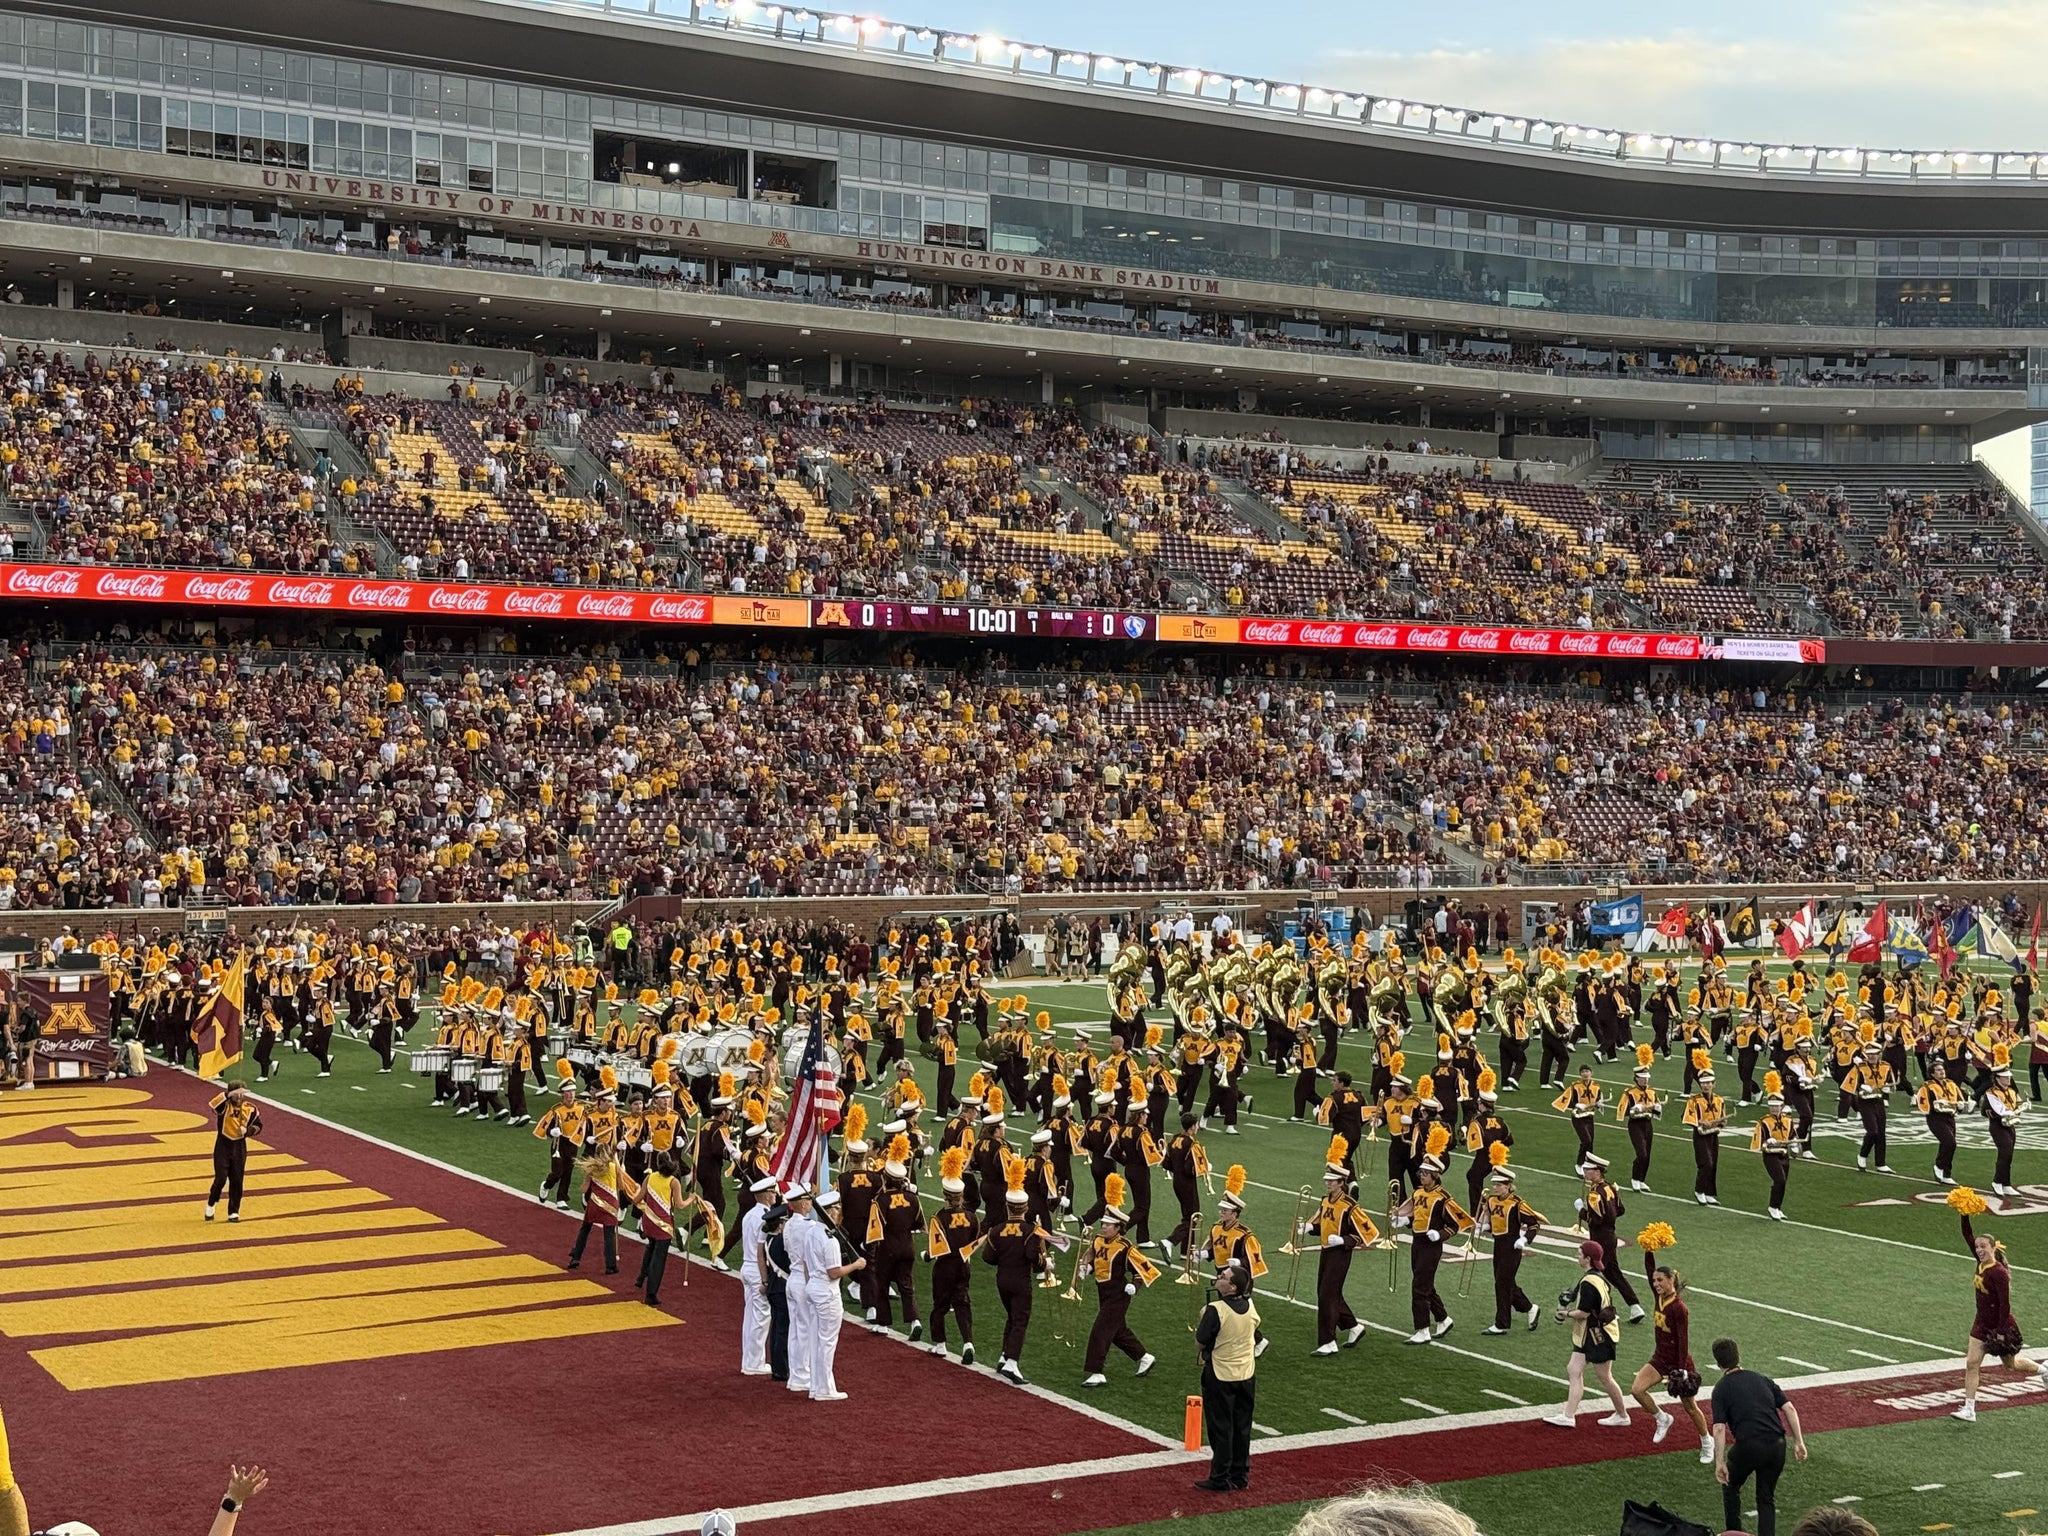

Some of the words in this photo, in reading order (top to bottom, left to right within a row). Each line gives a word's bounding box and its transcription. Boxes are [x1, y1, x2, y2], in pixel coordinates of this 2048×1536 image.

[262, 170, 462, 210] UNIVERSITY
[478, 197, 514, 215] OF
[532, 203, 703, 237] MINNESOTA
[767, 231, 791, 249] M
[857, 241, 1026, 274] HUNTINGTON
[1039, 262, 1104, 282] BANK
[1116, 269, 1221, 294] STADIUM
[9, 569, 83, 594] Coca-Cola
[97, 573, 168, 598] Coca-Cola
[185, 577, 254, 601] Coca-Cola
[268, 580, 335, 604] Coca-Cola
[348, 584, 413, 608] Coca-Cola
[428, 587, 491, 611] Coca-Cola
[504, 591, 565, 614] Coca-Cola
[576, 594, 636, 617] Coca-Cola
[649, 597, 706, 620] Coca-Cola
[816, 602, 850, 626] M
[862, 604, 874, 626] 0
[968, 608, 1016, 633] 10:01
[1031, 620, 1037, 633] 1
[1102, 614, 1114, 635] 0
[1245, 622, 1291, 641] Coca-Cola
[1299, 624, 1344, 643] Coca-Cola
[1354, 626, 1398, 645] Coca-Cola
[1407, 628, 1450, 647] Coca-Cola
[1458, 630, 1500, 649] Coca-Cola
[1510, 632, 1551, 651] Coca-Cola
[1559, 634, 1600, 653] Coca-Cola
[1607, 636, 1647, 654] Coca-Cola
[1656, 638, 1695, 656] Coca-Cola
[40, 1002, 96, 1035] M
